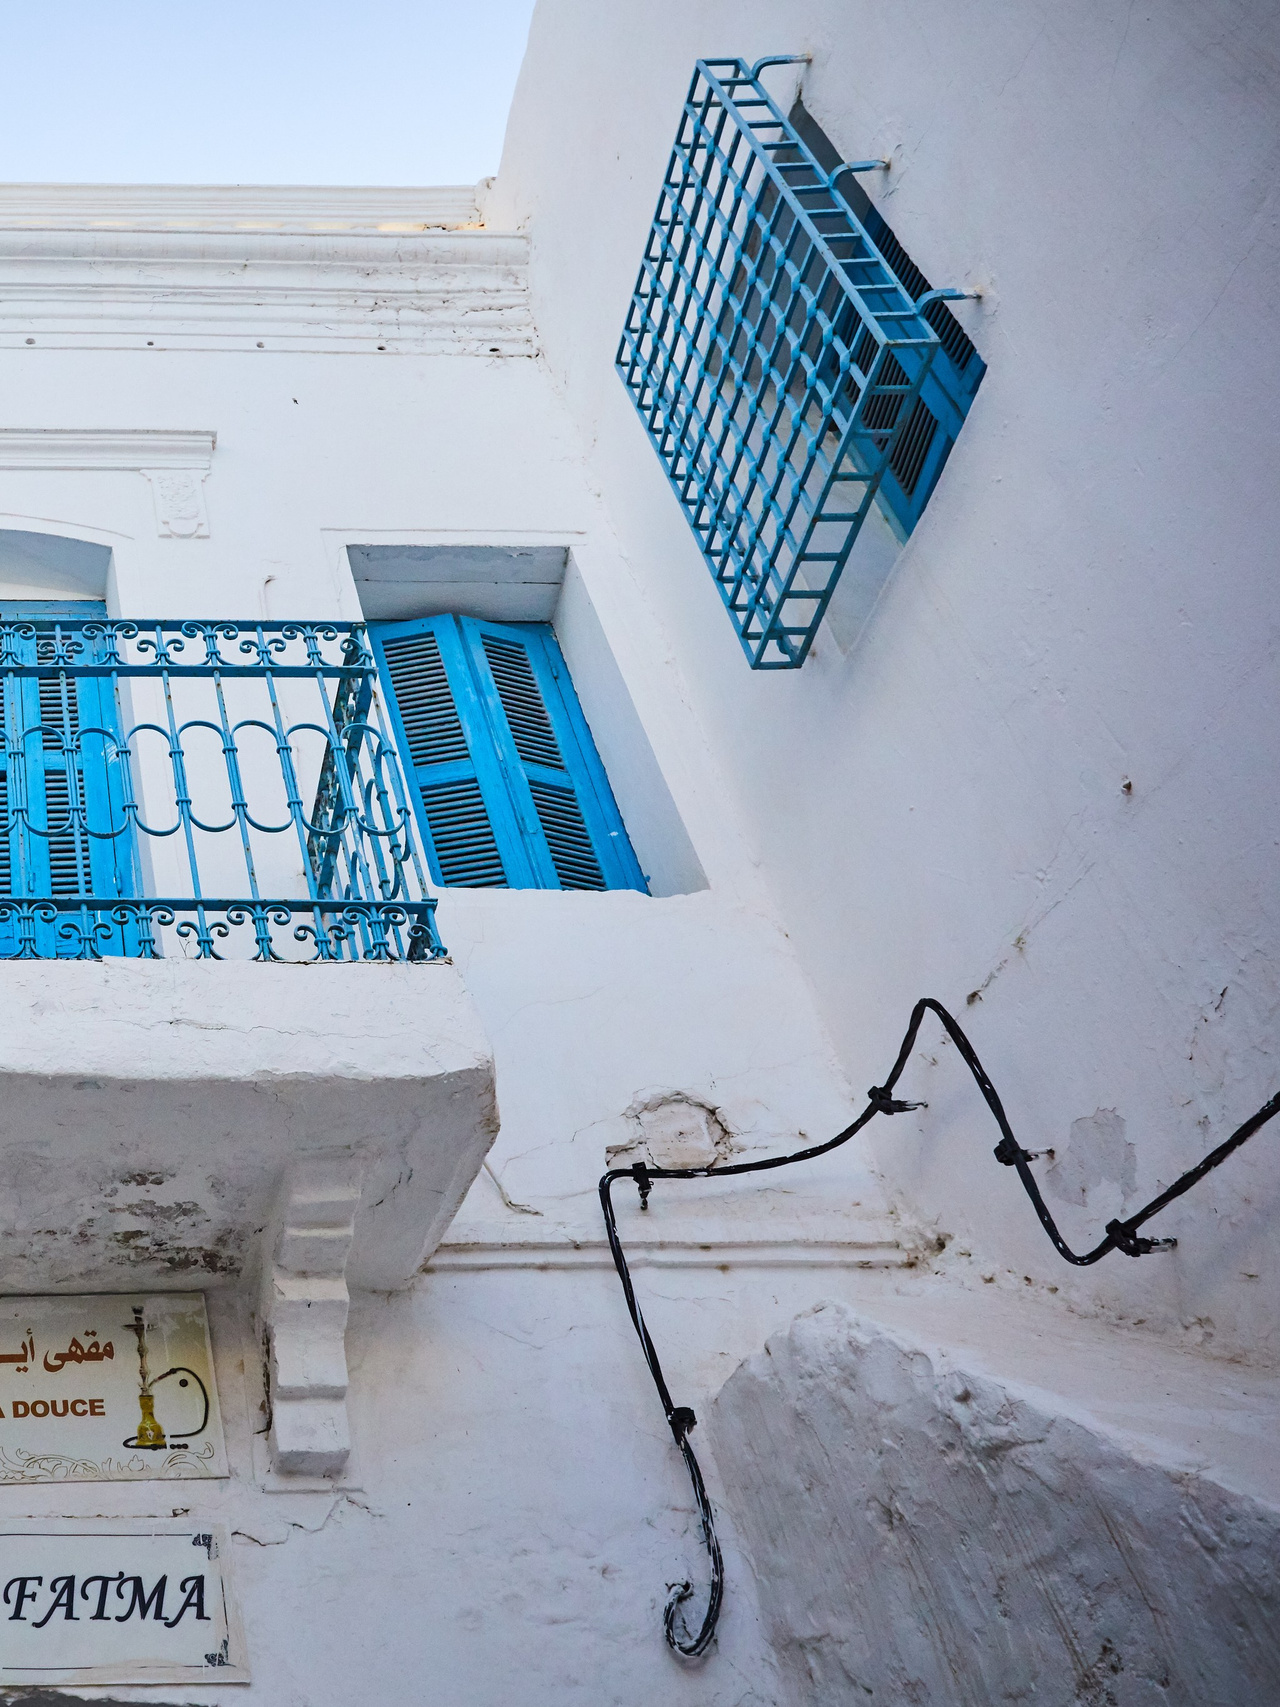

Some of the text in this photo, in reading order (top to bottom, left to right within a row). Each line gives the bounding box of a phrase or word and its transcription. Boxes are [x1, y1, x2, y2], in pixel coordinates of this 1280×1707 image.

[43, 1329, 114, 1373] مقهى
[12, 1398, 106, 1418] DOUCE
[3, 1570, 212, 1629] FATMA
